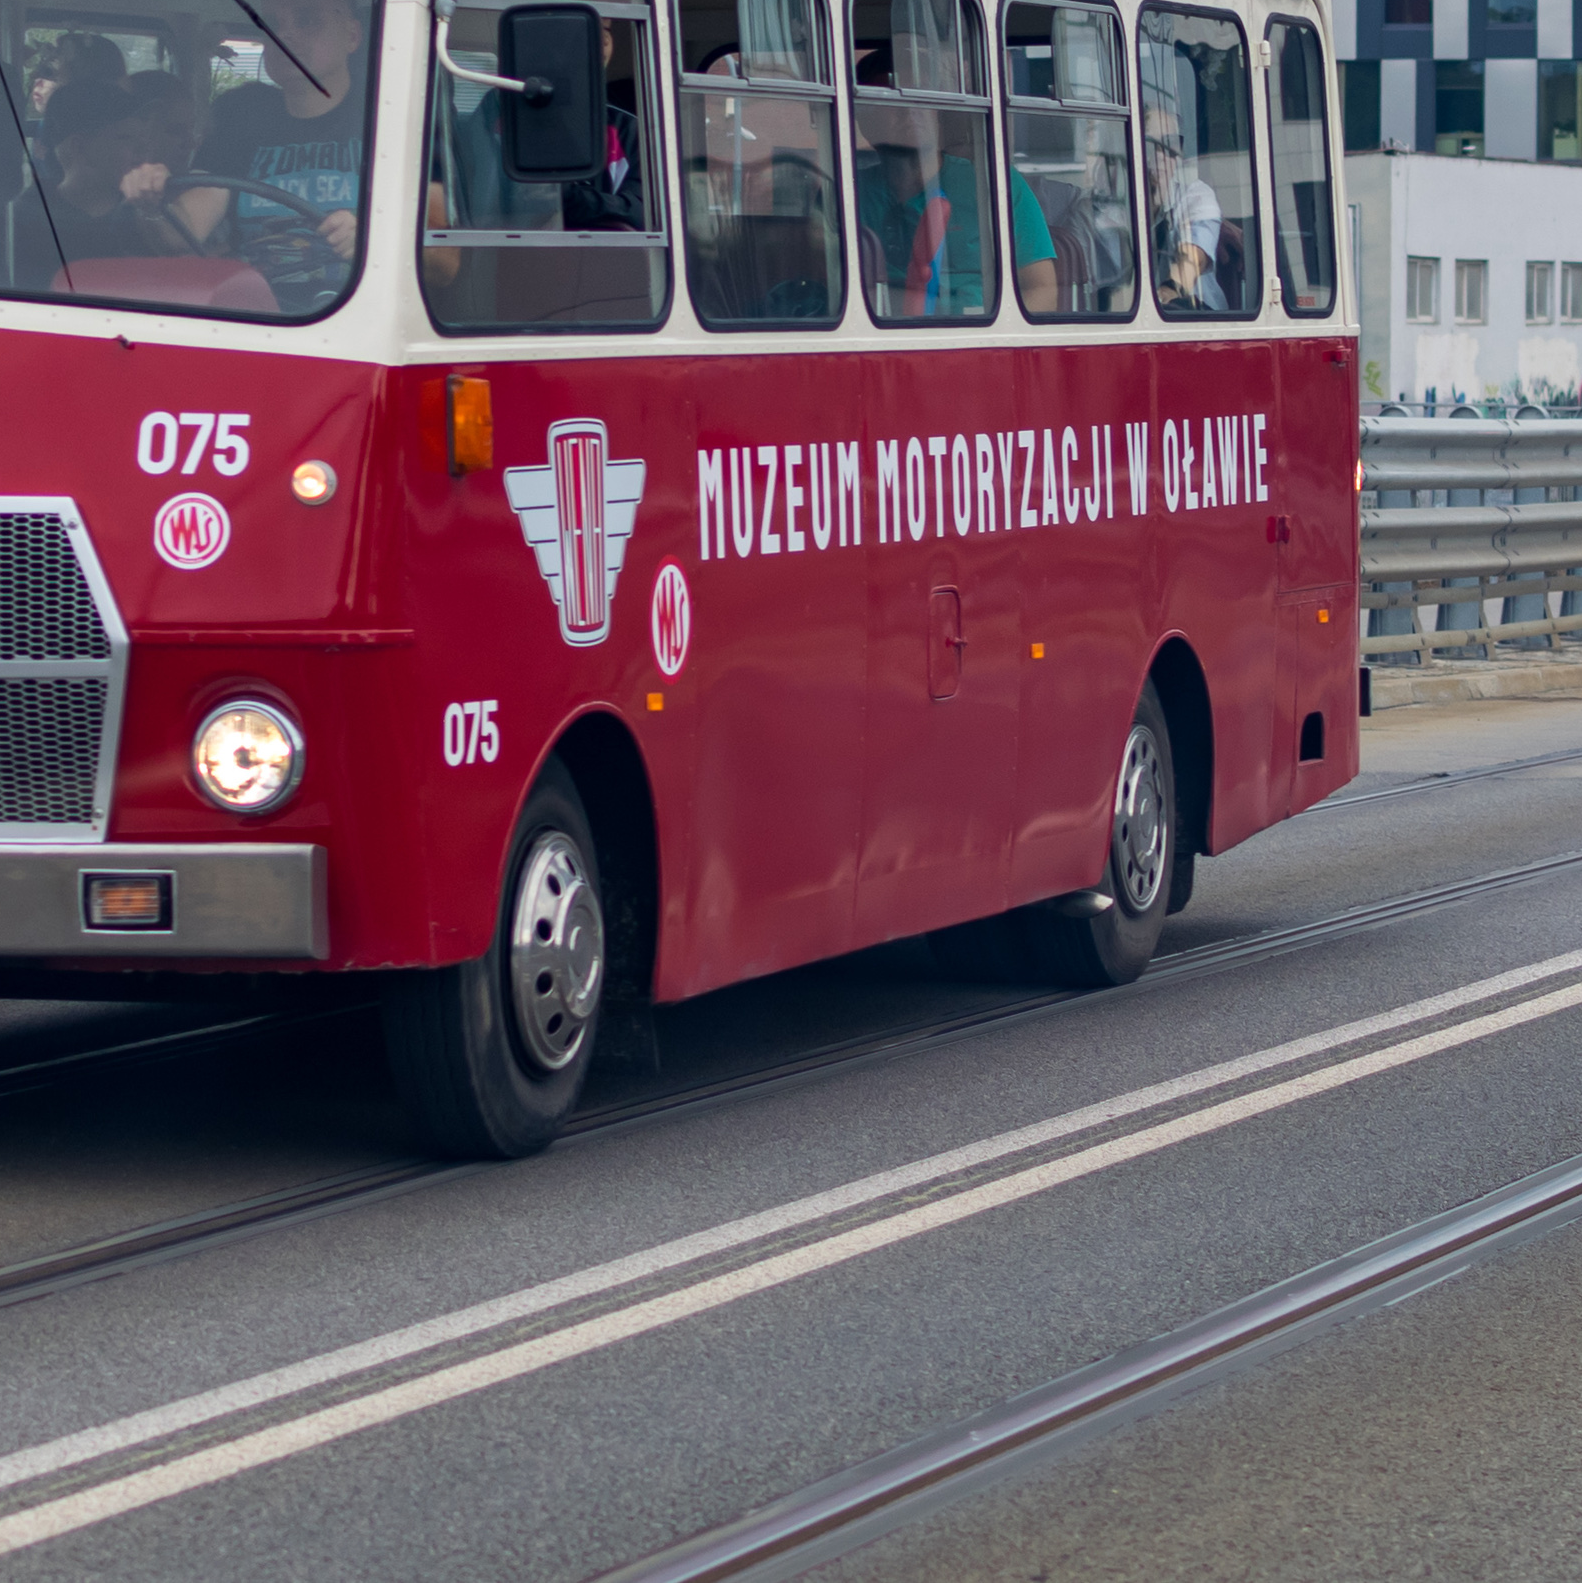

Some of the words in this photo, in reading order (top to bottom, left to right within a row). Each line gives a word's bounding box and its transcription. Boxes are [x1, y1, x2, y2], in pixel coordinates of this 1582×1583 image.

[317, 174, 353, 203] SEA
[137, 411, 251, 477] 075
[697, 441, 862, 560] MUZEUM
[876, 424, 1114, 543] MOTORYZACJI
[1125, 421, 1148, 516] W
[1162, 413, 1268, 513] OŁAWIE
[443, 700, 500, 767] 075
